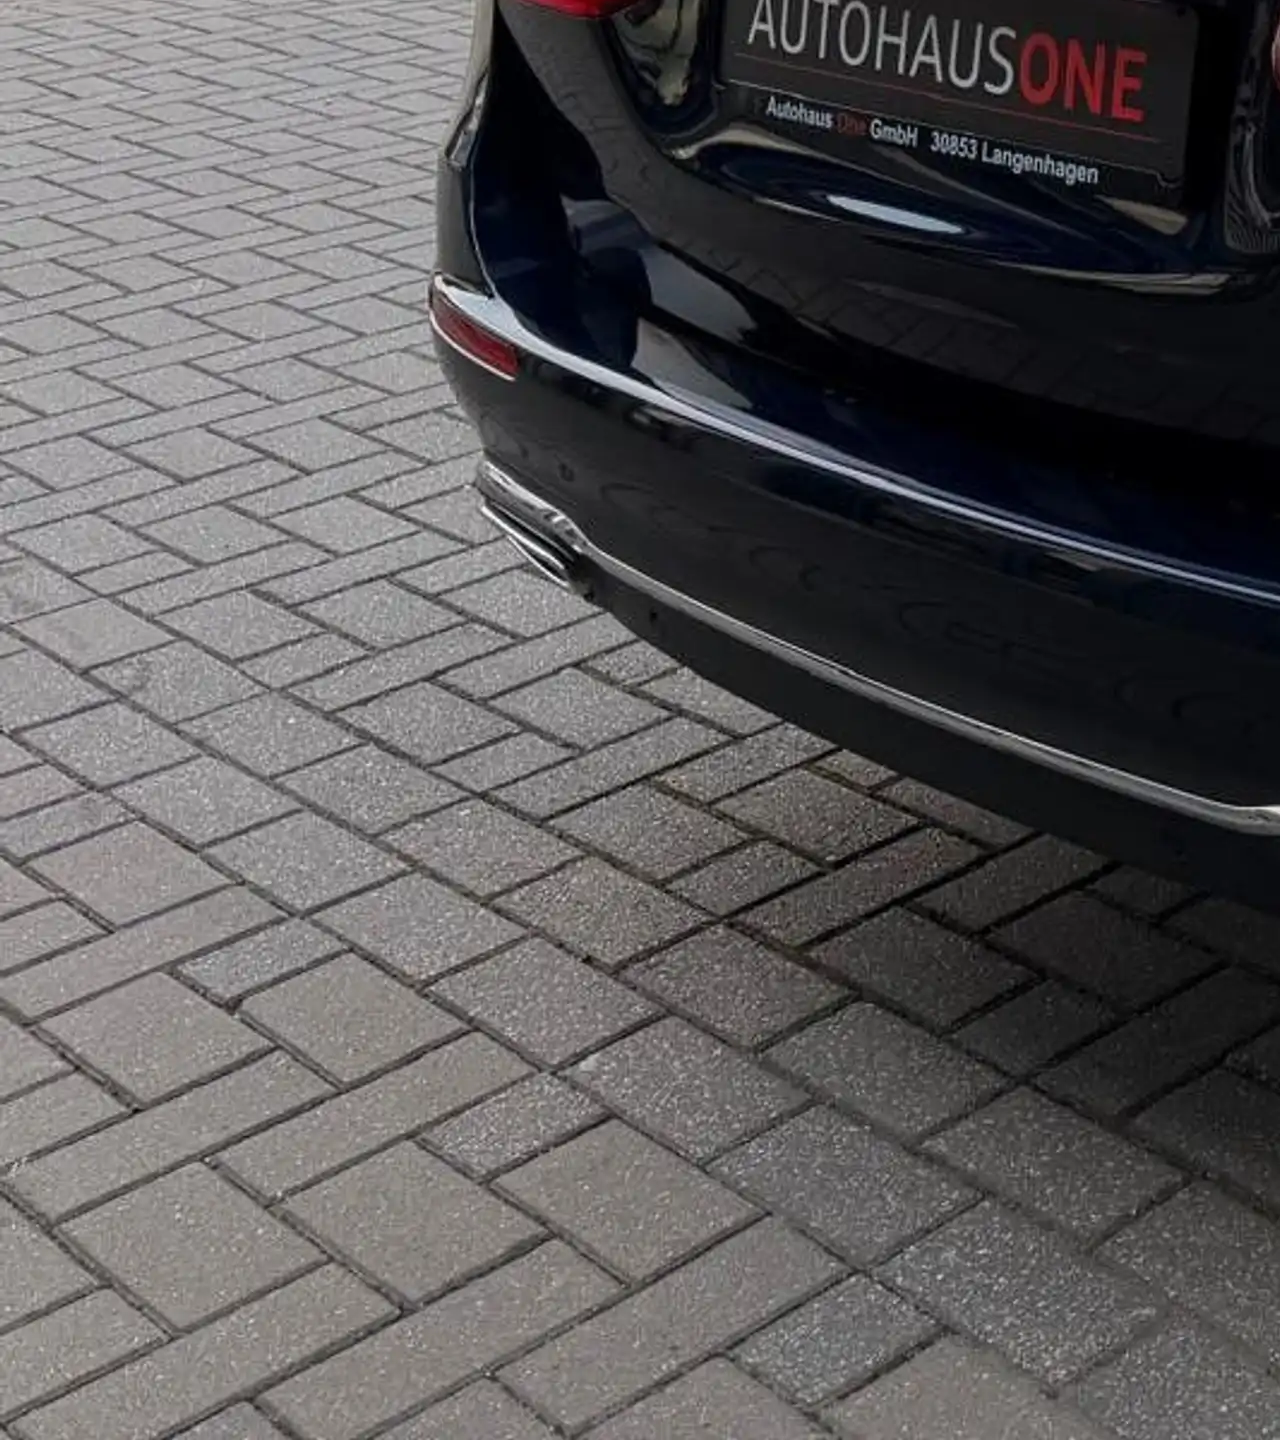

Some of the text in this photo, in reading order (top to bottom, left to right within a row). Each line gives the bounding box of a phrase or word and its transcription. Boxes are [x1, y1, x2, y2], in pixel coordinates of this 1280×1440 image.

[766, 96, 1099, 185] Autohaus One GmbH 30853 Langenhagen
